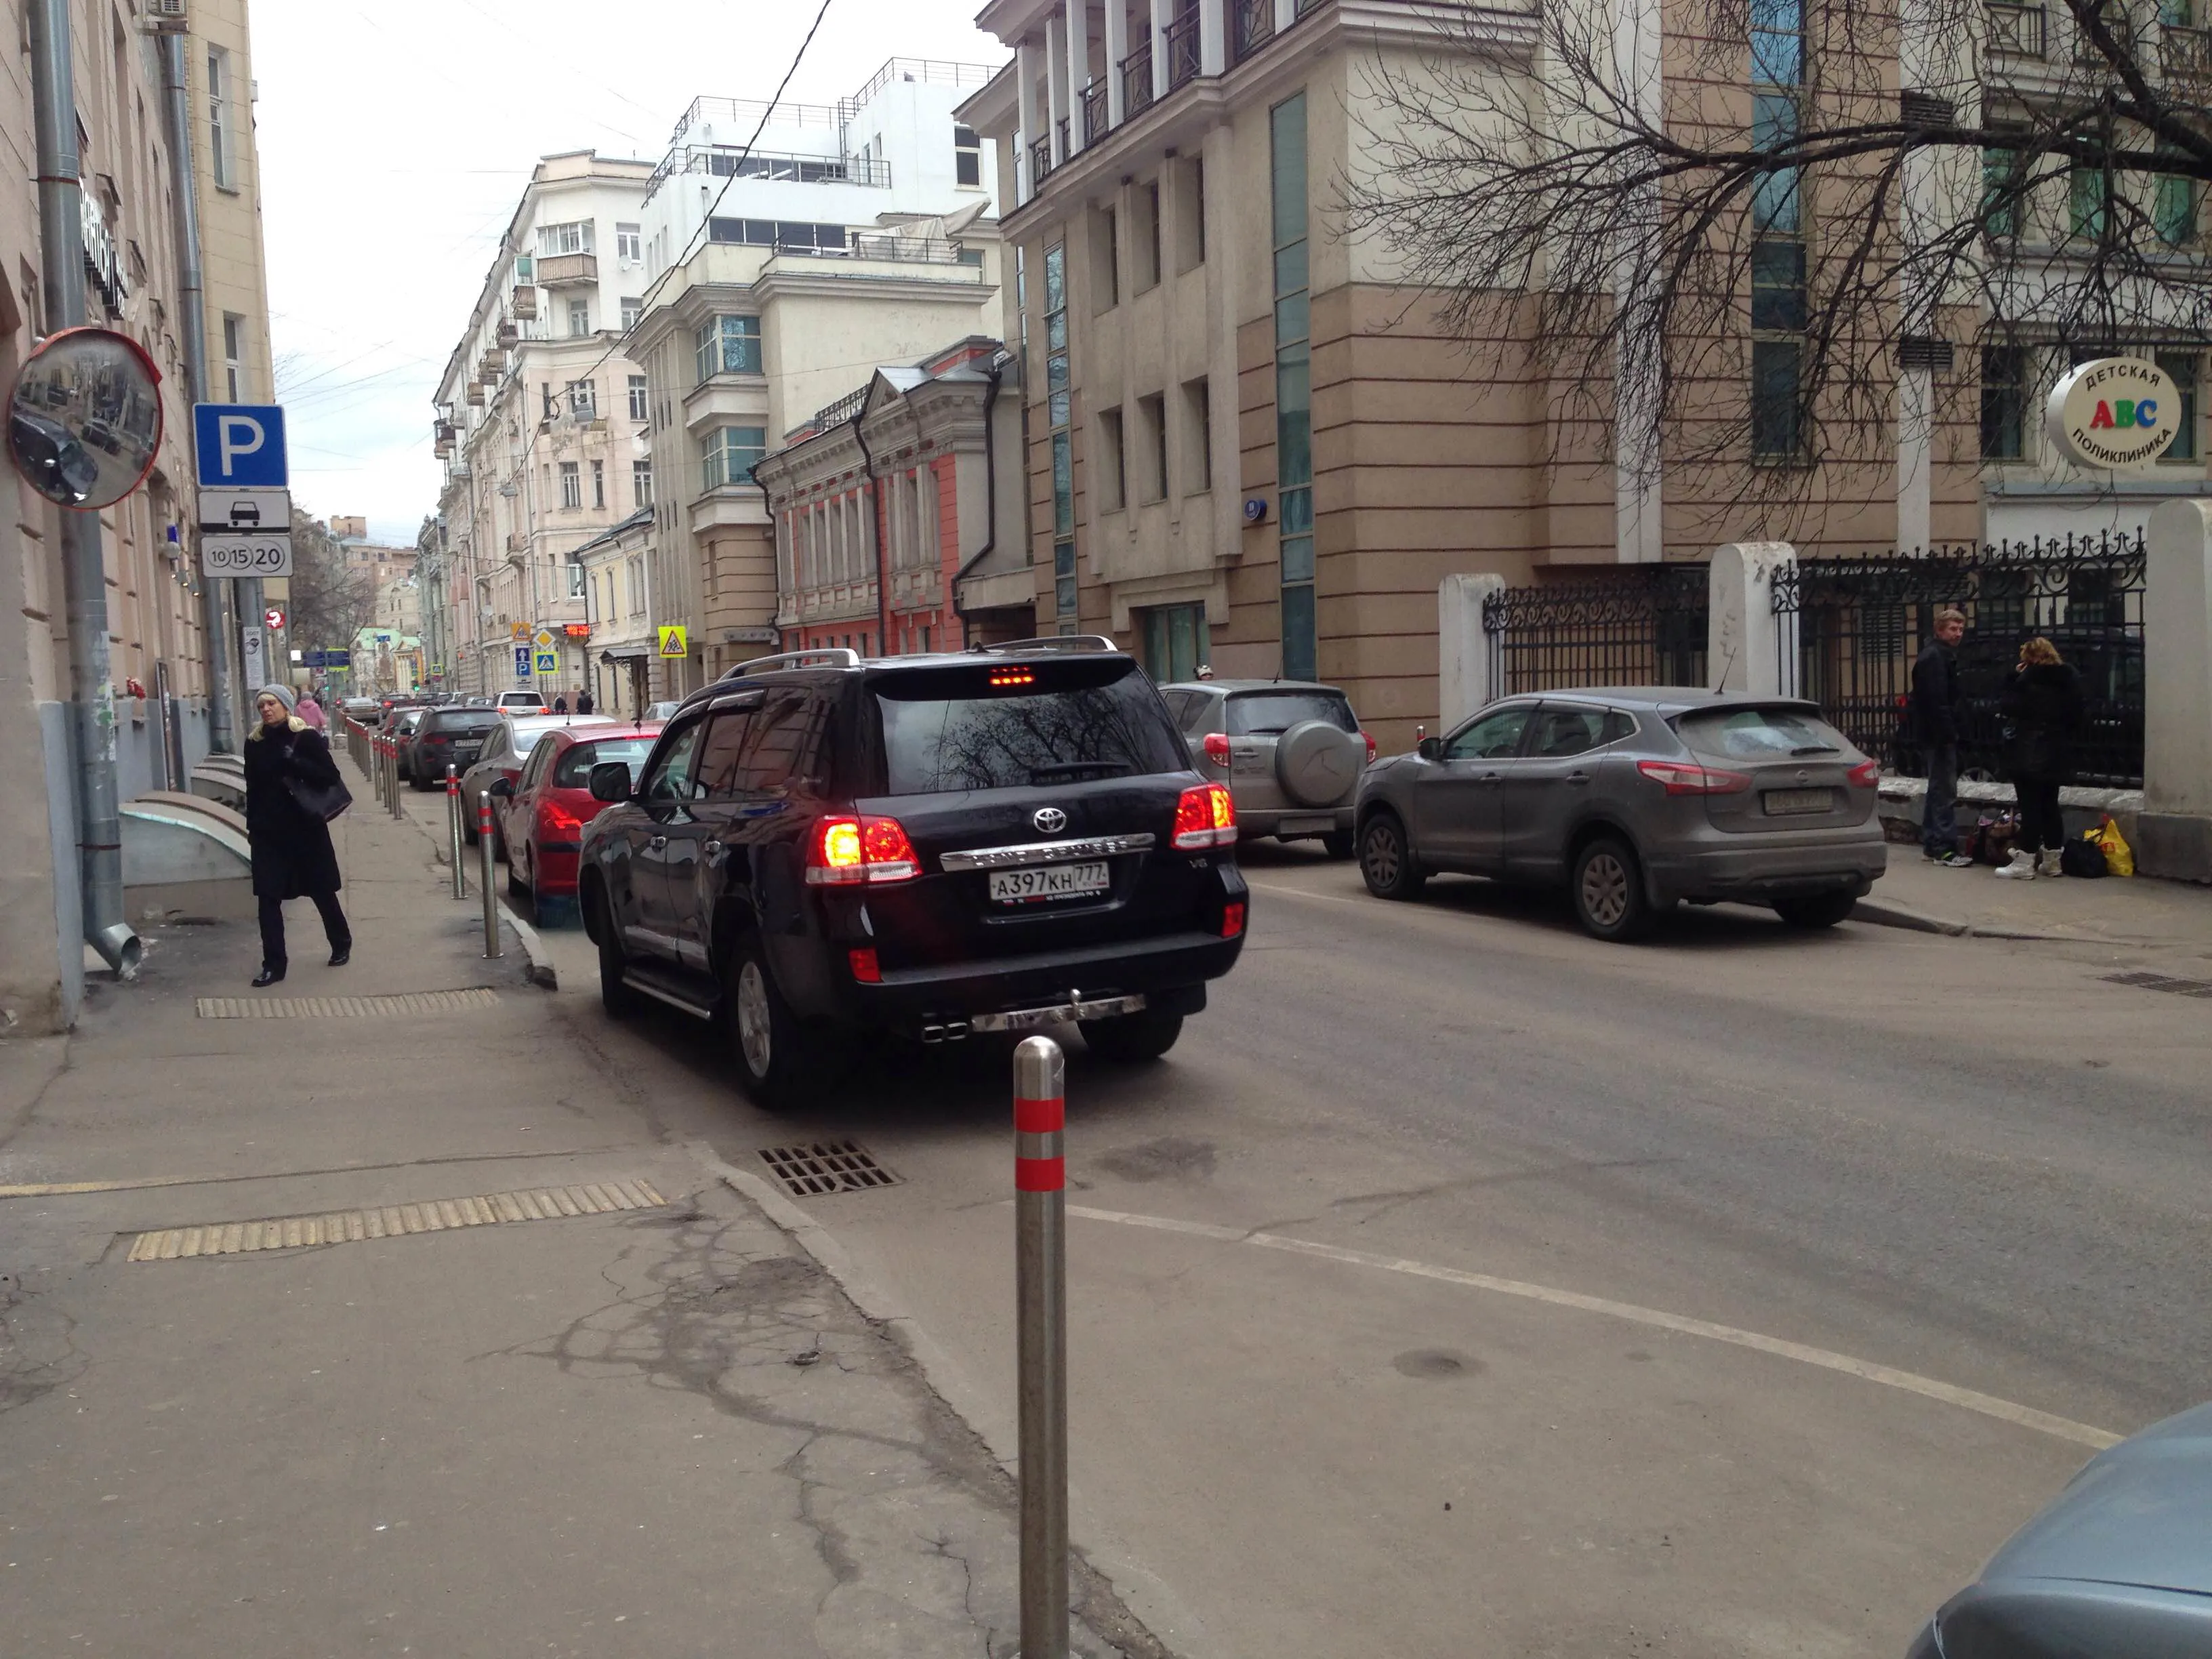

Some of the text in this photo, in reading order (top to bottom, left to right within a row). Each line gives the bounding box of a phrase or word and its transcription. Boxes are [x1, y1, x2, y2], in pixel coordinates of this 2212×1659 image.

[2085, 365, 2160, 391] ДЕТСКАЯ
[2089, 399, 2158, 430] ABC
[218, 415, 265, 476] P
[2072, 428, 2172, 464] ПОЛИКЛИНИКА
[212, 548, 281, 565] 10 15 20
